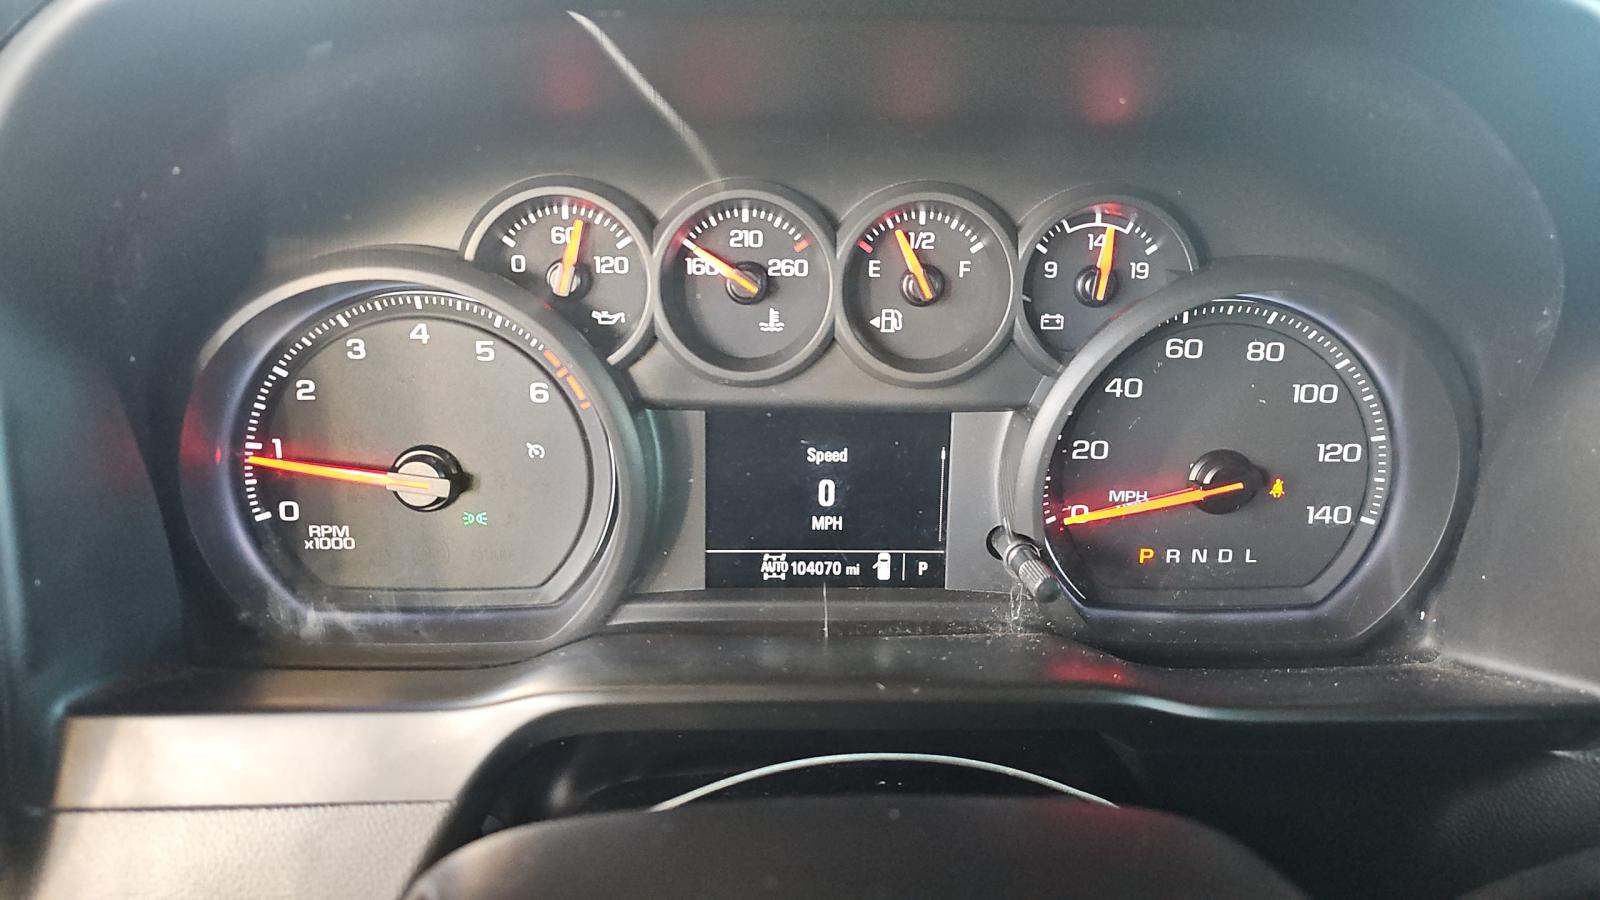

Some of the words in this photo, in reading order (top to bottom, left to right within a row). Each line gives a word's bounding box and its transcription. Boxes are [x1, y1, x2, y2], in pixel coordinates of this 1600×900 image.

[729, 229, 763, 248] 210
[907, 231, 936, 250] 1/2
[510, 255, 526, 273] 0
[594, 255, 629, 274] 120
[686, 257, 722, 276] 160
[767, 258, 808, 277] 260
[868, 260, 881, 278] E
[959, 260, 972, 278] F
[1043, 261, 1058, 278] 9
[1129, 261, 1149, 279] 19
[409, 323, 430, 344] 4
[346, 339, 367, 360] 3
[475, 340, 495, 362] 5
[1165, 338, 1204, 359] 60
[1246, 341, 1285, 362] 80
[296, 379, 316, 401] 2
[529, 381, 550, 403] 6
[1104, 377, 1143, 398] 40
[1292, 383, 1339, 404] 100
[271, 438, 283, 459] 1
[806, 447, 848, 465] Speed
[1071, 440, 1109, 460] 20
[1317, 443, 1362, 463] 120
[817, 478, 836, 507] 0
[1108, 490, 1148, 504] MPH
[278, 500, 300, 522] 0
[1306, 505, 1352, 525] 140
[308, 525, 349, 538] RPM
[811, 516, 843, 531] MPH
[1139, 548, 1155, 564] P
[1165, 549, 1181, 564] R
[1191, 549, 1208, 564] N
[1218, 549, 1233, 563] D
[1245, 549, 1257, 563] L
[760, 561, 789, 574] AUTO
[790, 561, 841, 576] 104070
[845, 563, 860, 576] mi
[918, 561, 928, 576] P
